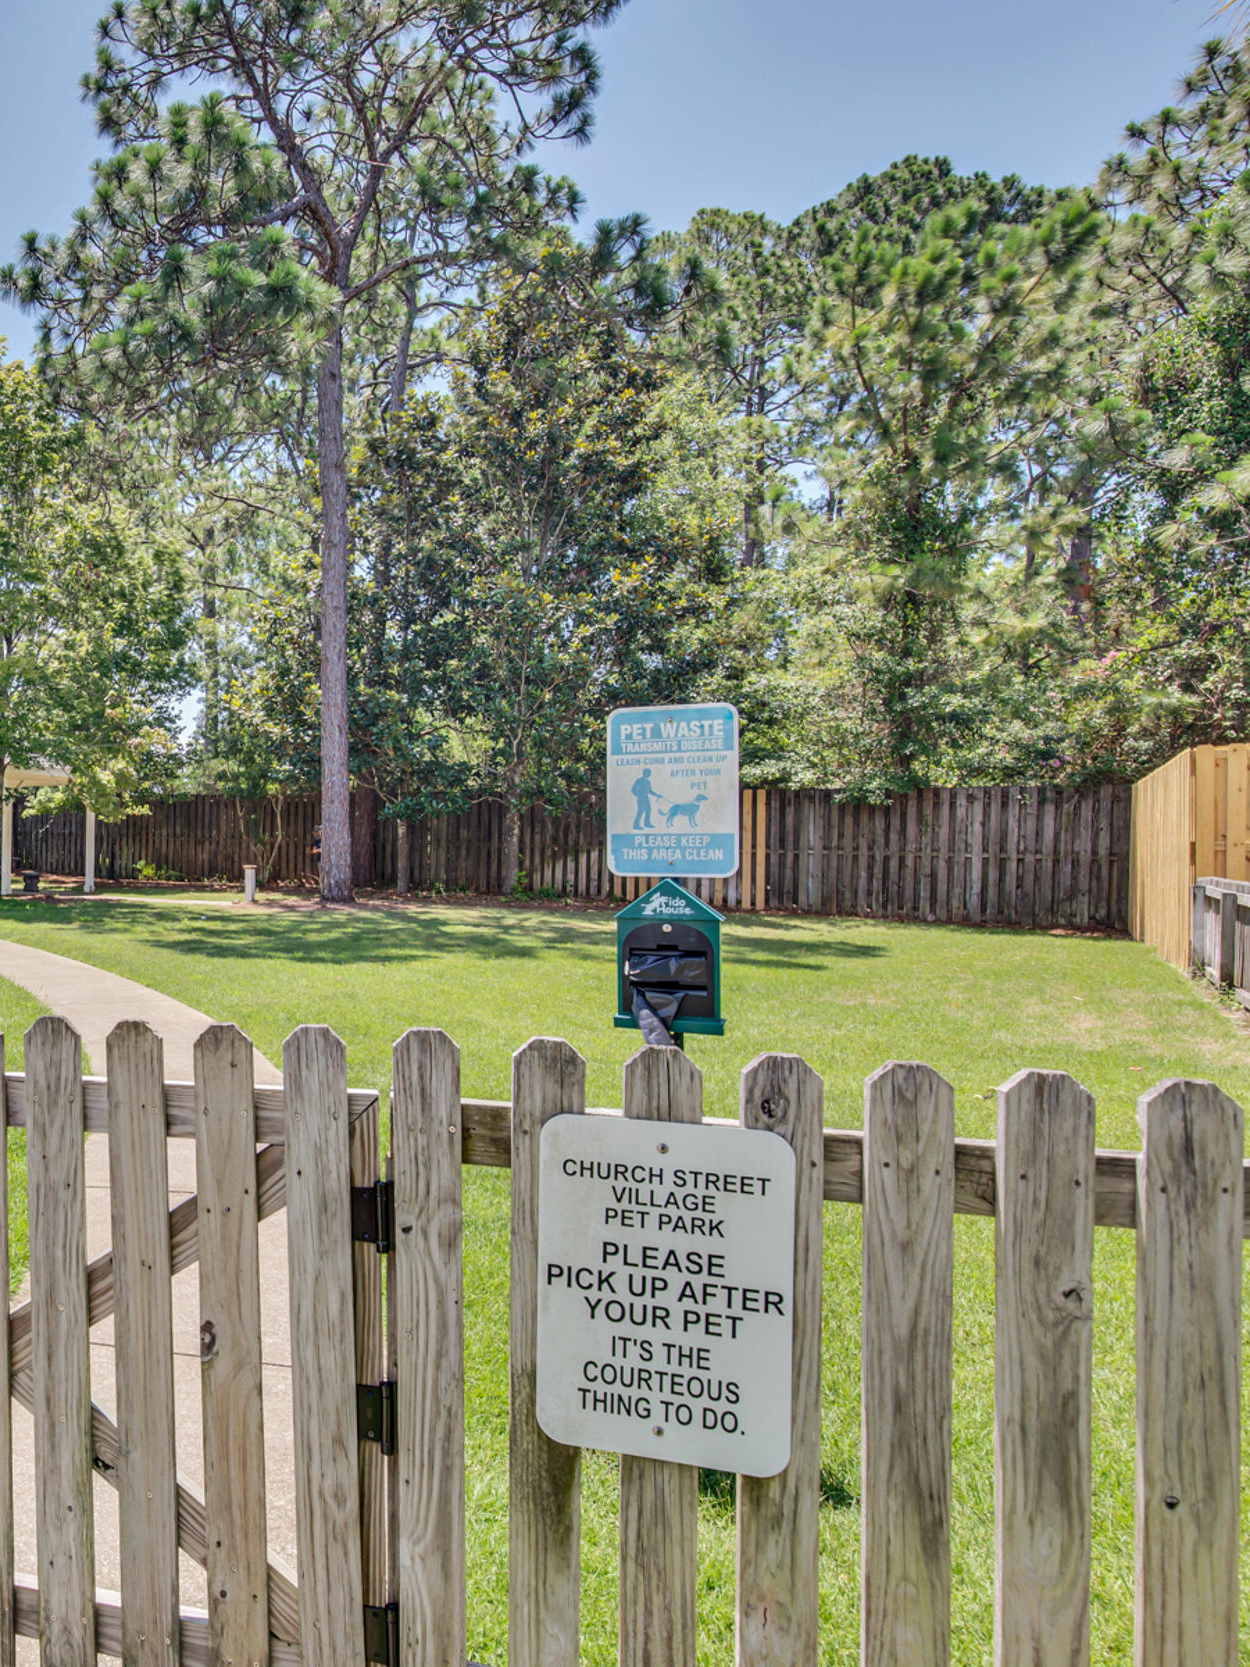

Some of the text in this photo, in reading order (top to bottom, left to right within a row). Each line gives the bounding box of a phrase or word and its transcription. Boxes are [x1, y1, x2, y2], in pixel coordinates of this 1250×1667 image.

[620, 720, 725, 740] PET WASTE
[621, 738, 724, 754] TRANSMITS DISEASE
[668, 756, 684, 764] AND
[686, 756, 713, 764] CLEAN
[716, 754, 727, 762] UP
[670, 768, 722, 778] AFTER YOUR
[690, 782, 708, 790] PET
[622, 848, 724, 861] THIS AREA CLEAN
[634, 835, 710, 848] PLEASE KEEP
[656, 906, 690, 914] House
[563, 1159, 771, 1196] CHURCH STREET
[612, 1186, 715, 1213] VILLAGE
[605, 1208, 724, 1238] PET PARK
[603, 1242, 725, 1278] PLEASE
[547, 1264, 784, 1316] PICK UP AFTER
[584, 1296, 743, 1339] YOUR PET
[612, 1336, 710, 1371] IT'S THE
[584, 1361, 739, 1404] COURTEOUS
[578, 1388, 744, 1435] THING TO DO.
